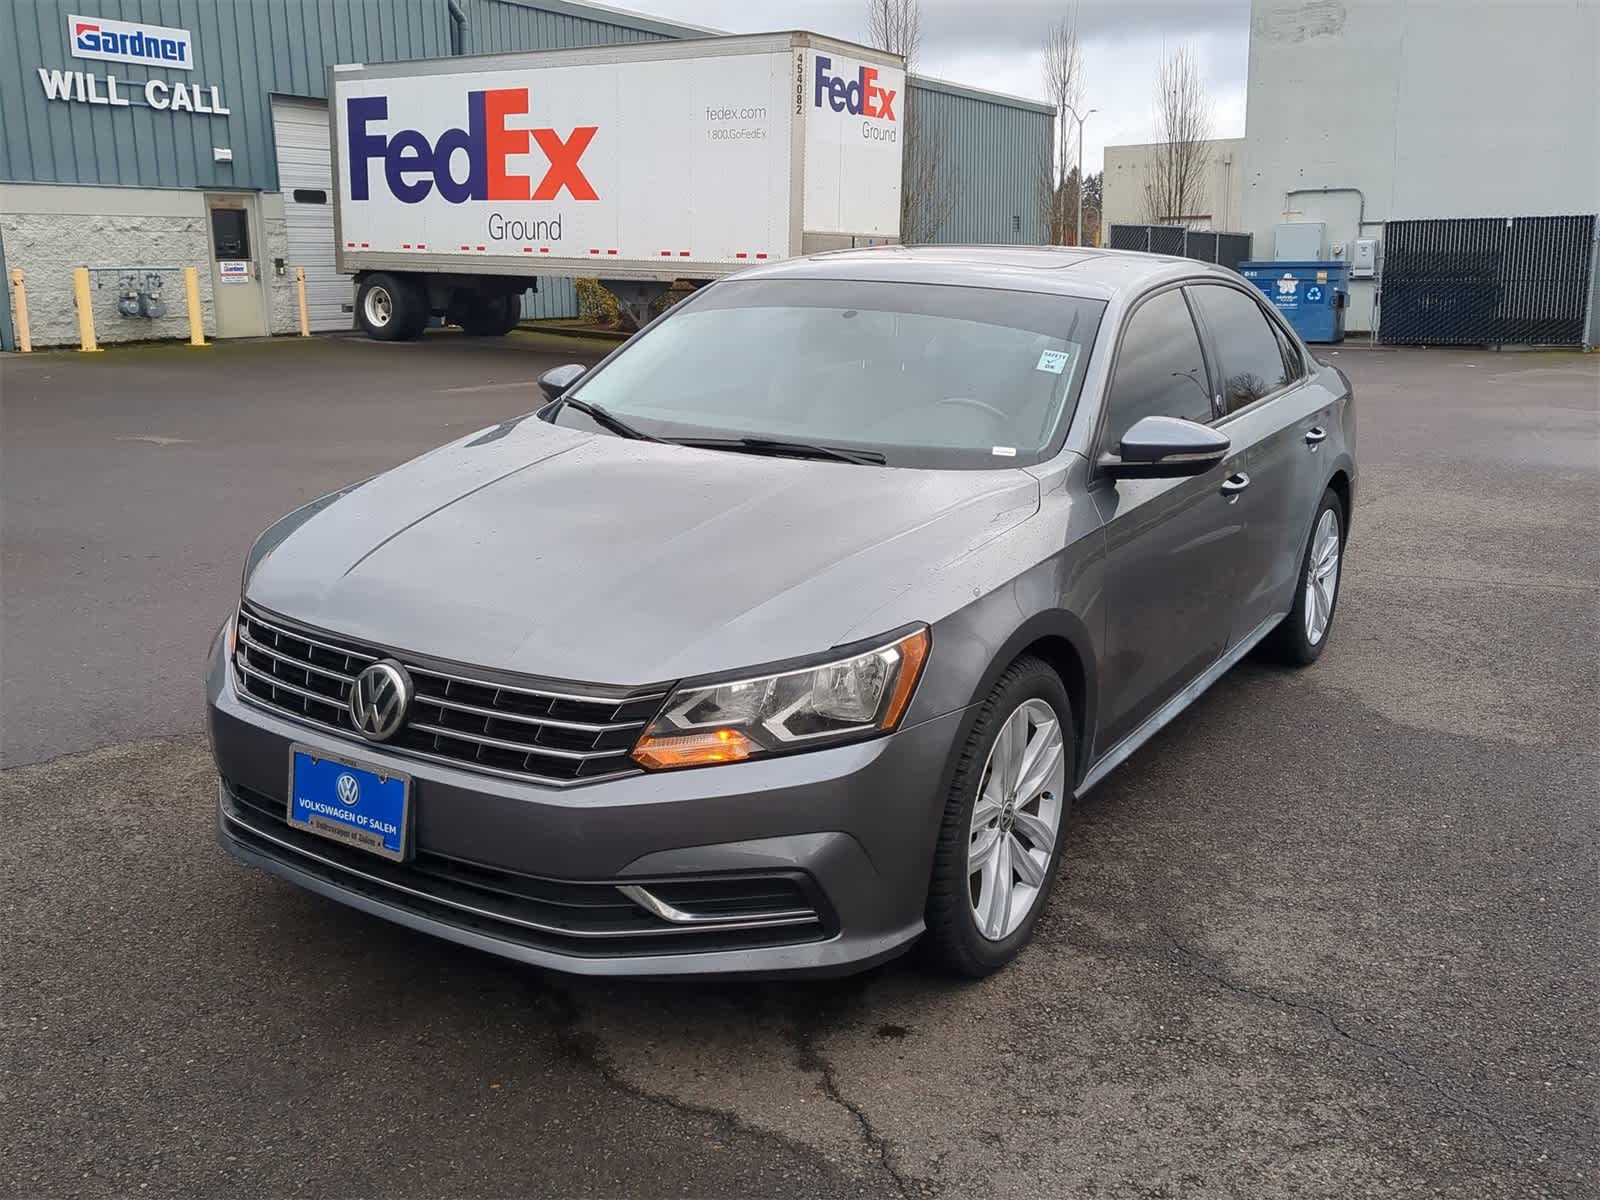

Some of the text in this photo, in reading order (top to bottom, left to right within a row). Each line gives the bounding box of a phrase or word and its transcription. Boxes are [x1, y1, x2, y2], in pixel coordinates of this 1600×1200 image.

[75, 23, 187, 61] Gardner
[38, 68, 231, 115] WILL CALL
[814, 55, 897, 121] FedEx
[705, 105, 767, 121] fedex.com
[862, 121, 897, 142] Ground
[347, 88, 601, 204] FedEx
[488, 213, 562, 241] Ground
[299, 798, 397, 835] VOLKSWAGEN OF SALEM
